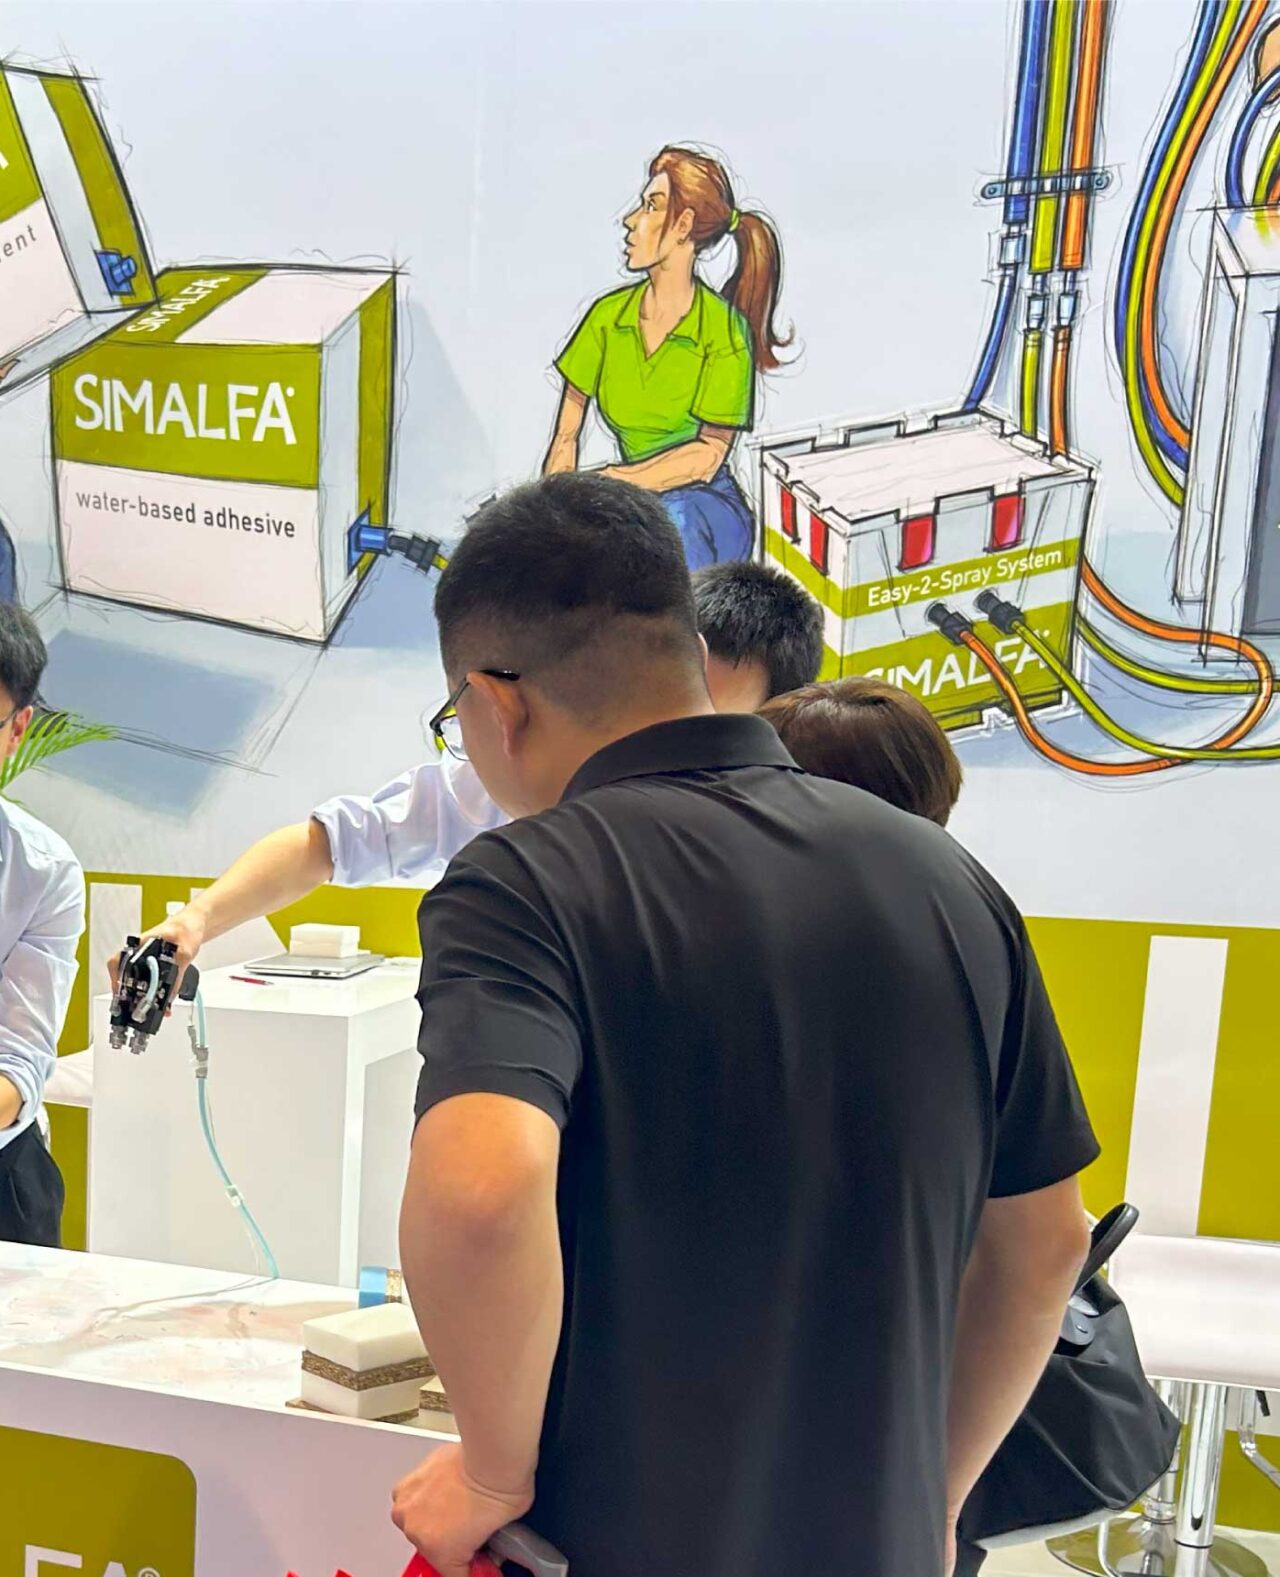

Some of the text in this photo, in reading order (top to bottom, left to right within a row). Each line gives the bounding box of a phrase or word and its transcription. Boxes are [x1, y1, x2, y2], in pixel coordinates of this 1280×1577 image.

[76, 491, 296, 539] water-based adhesive
[868, 550, 1062, 607] Easy-2-Spray System
